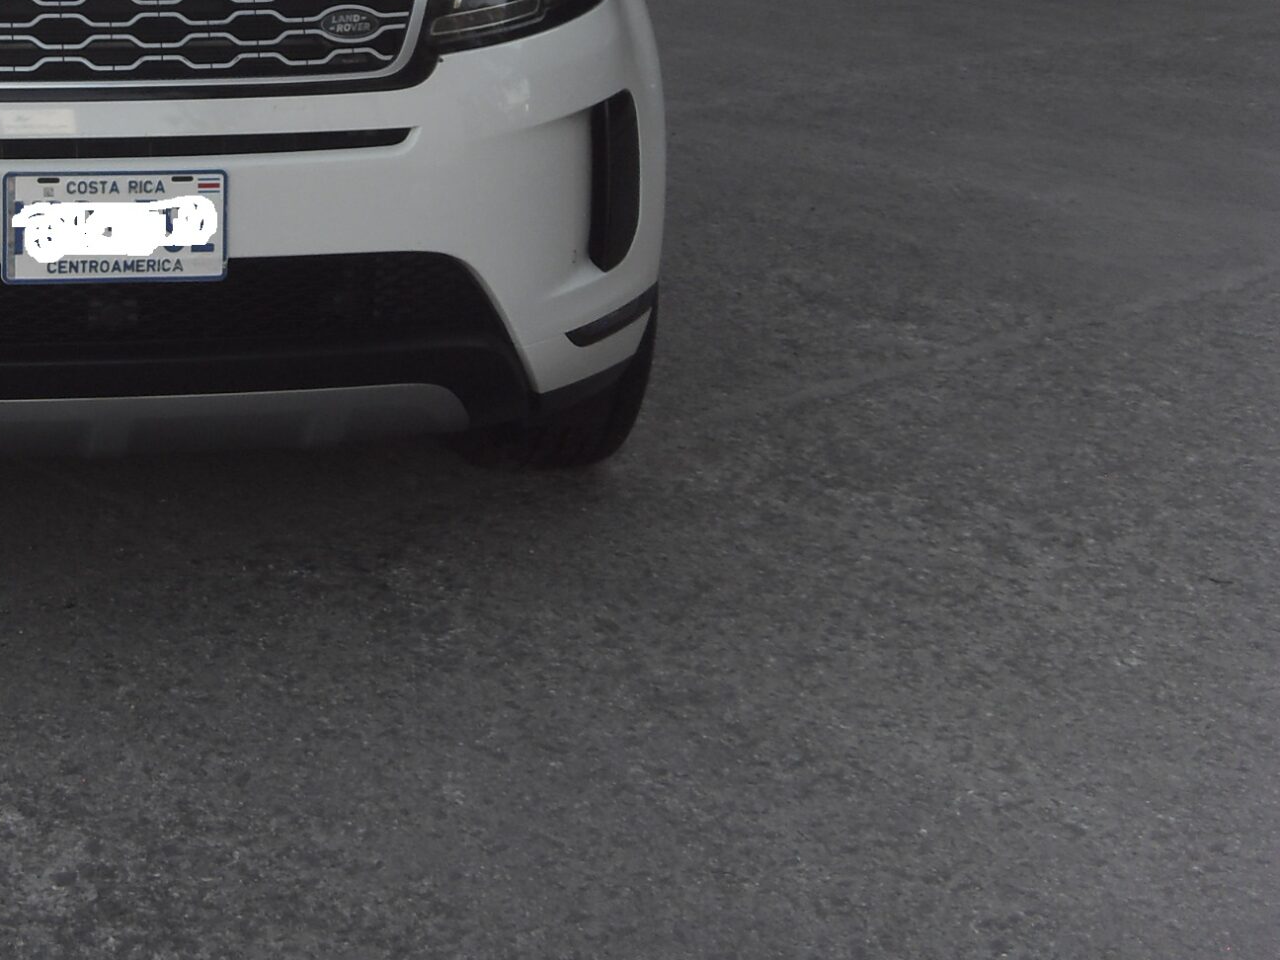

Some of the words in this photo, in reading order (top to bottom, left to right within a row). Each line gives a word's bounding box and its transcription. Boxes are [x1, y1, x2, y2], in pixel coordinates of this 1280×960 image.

[66, 180, 120, 195] COSTA
[128, 179, 166, 194] RICA
[46, 258, 184, 274] CENTROAMERICA
